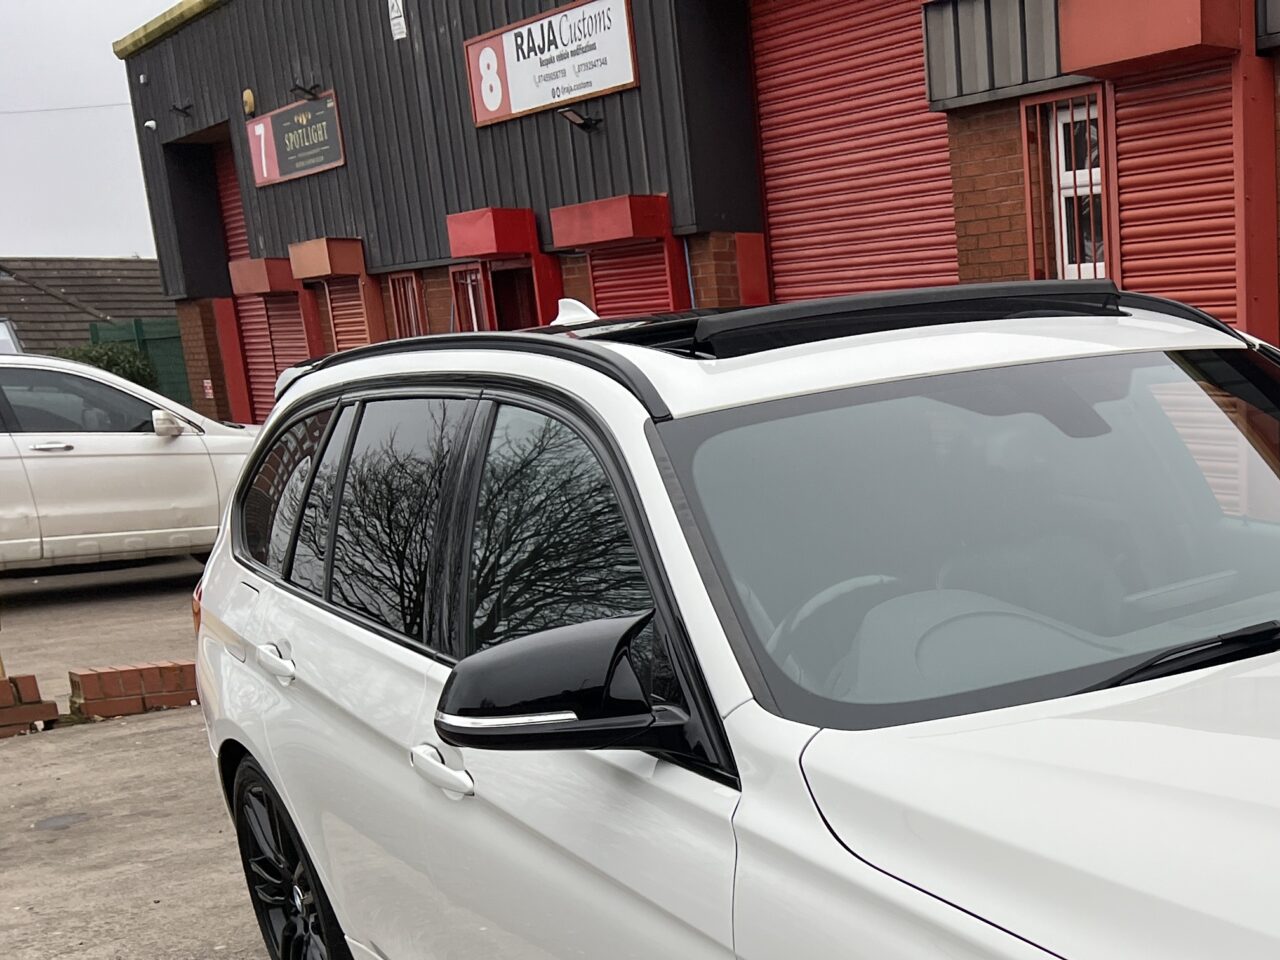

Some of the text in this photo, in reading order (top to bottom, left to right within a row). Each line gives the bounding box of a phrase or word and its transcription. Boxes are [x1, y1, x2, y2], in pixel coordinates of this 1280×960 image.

[514, 7, 612, 62] RAJA Customs
[479, 47, 502, 111] 8
[254, 123, 267, 178] 7
[284, 121, 328, 151] SPOTLIGHT
